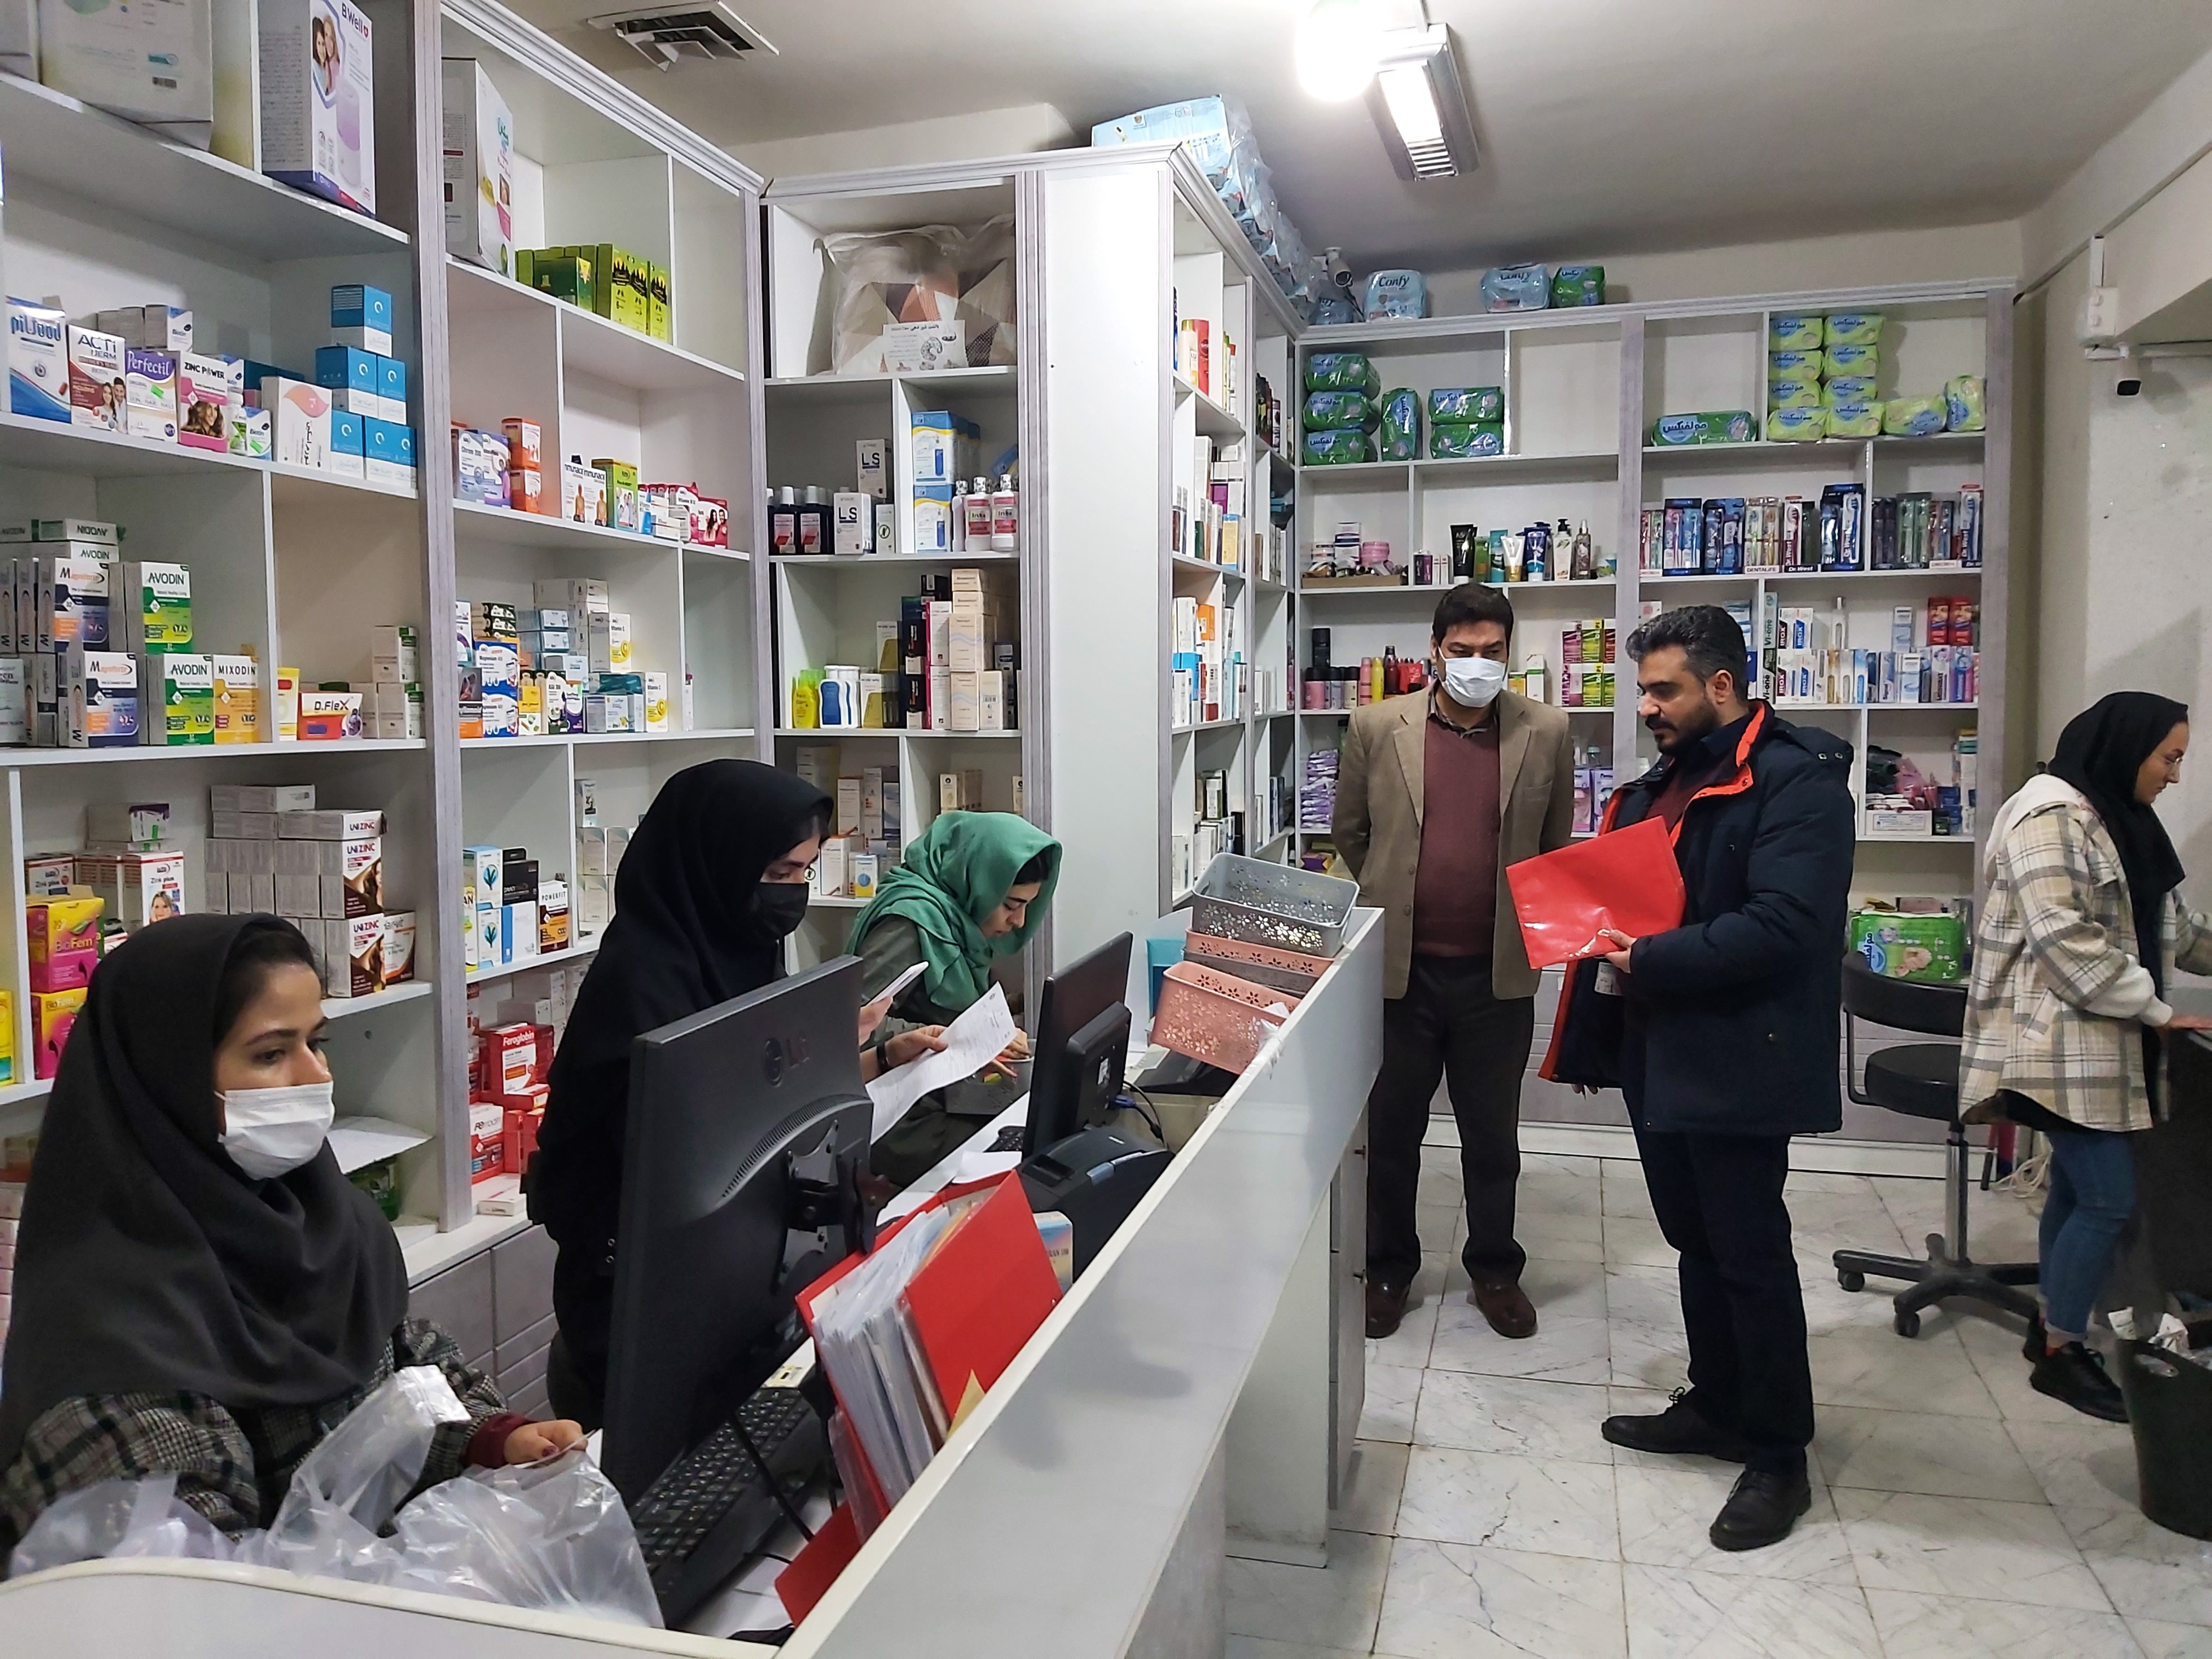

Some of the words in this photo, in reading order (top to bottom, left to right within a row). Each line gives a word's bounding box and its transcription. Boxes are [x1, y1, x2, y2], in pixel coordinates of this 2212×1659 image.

[1379, 275, 1409, 289] Confy
[91, 350, 116, 360] DERM
[127, 350, 171, 376] Perfectil
[184, 362, 200, 373] ZINC
[250, 428, 264, 437] Biotin
[1663, 420, 1707, 433] مولفیکس
[861, 453, 881, 466] LS
[838, 506, 857, 521] LS
[77, 524, 108, 537] AVODIN
[81, 549, 109, 560] AVODIN
[149, 572, 184, 585] AVODIN
[623, 642, 628, 652] C
[171, 664, 207, 676] AVODIN
[218, 665, 256, 675] MIXODIN
[659, 701, 664, 712] C
[360, 822, 375, 830] ZINC
[347, 845, 358, 854] UNI
[359, 843, 375, 853] ZINC
[541, 891, 566, 901] POWERFIT
[353, 923, 364, 933] UNI
[364, 919, 380, 931] ZINC
[55, 937, 92, 952] BioFem
[503, 1030, 535, 1047] Feroglobin
